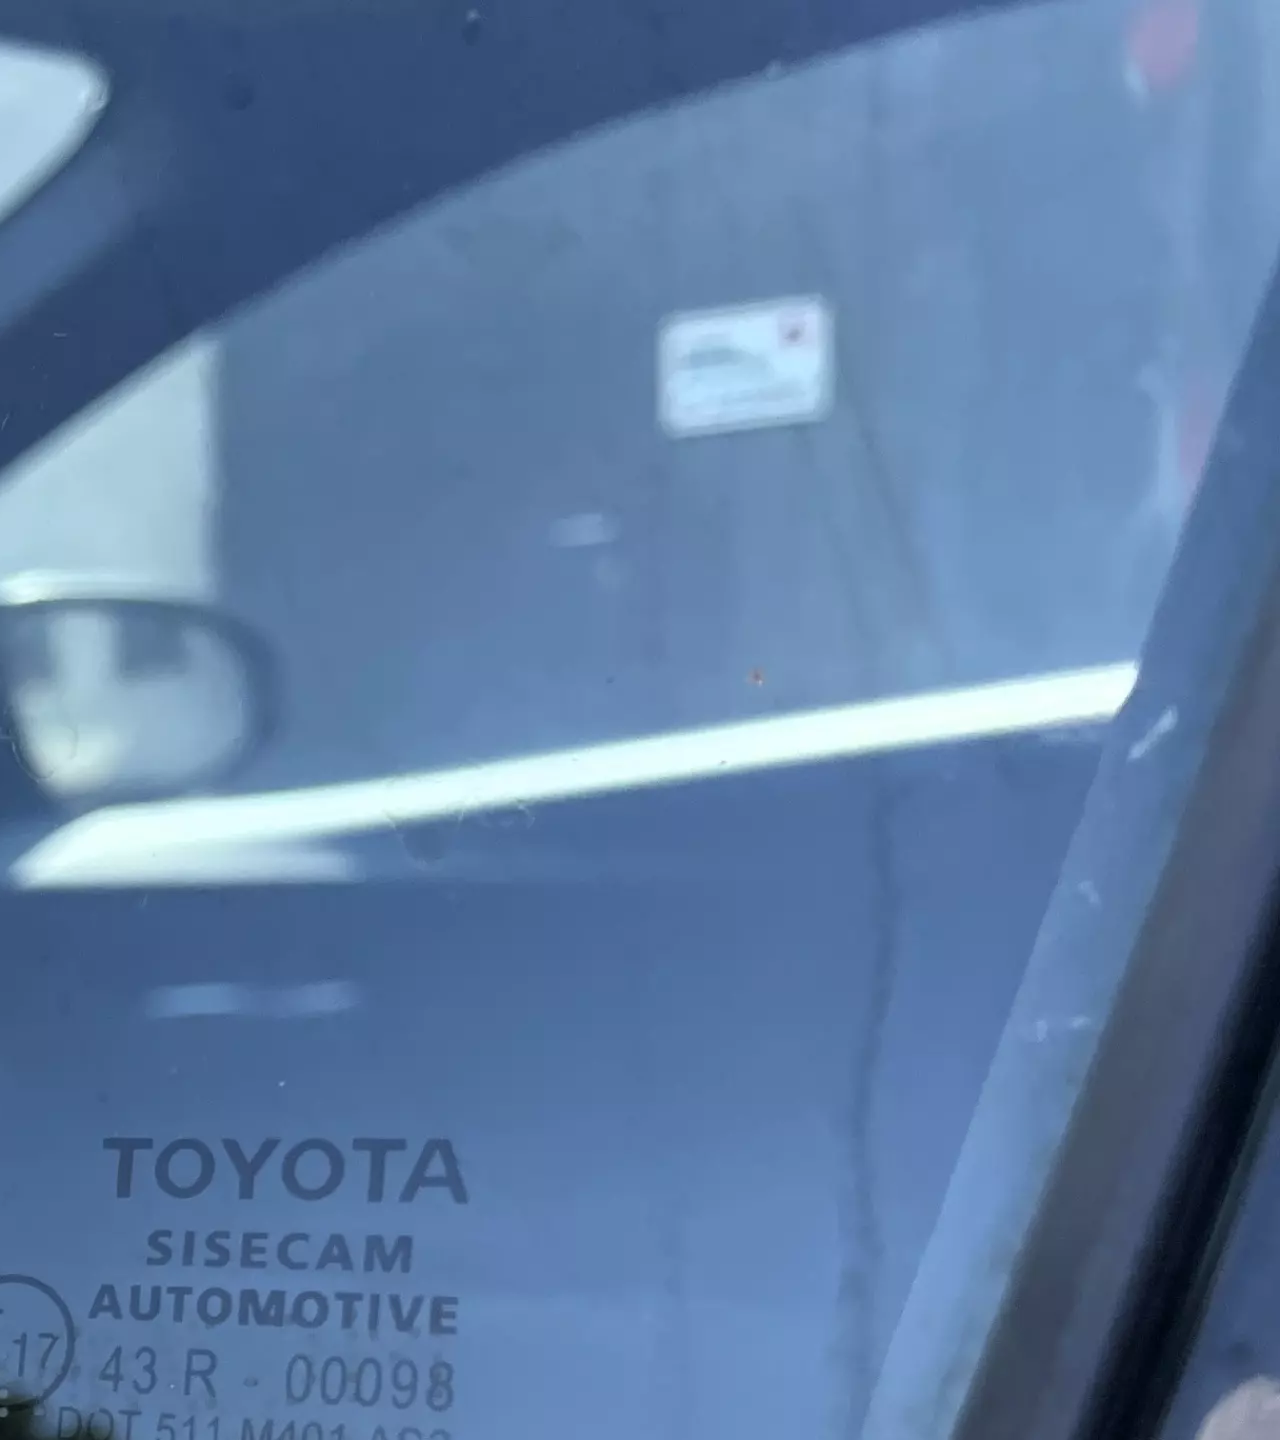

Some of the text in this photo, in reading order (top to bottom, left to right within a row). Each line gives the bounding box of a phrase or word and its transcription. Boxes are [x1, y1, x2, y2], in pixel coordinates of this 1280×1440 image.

[102, 1135, 470, 1205] TOYOTA
[145, 1228, 415, 1274] SISECAM
[87, 1283, 460, 1336] AUTOMOTIVE
[98, 1345, 158, 1396] 43
[183, 1347, 219, 1398] R
[284, 1353, 455, 1412] 00098
